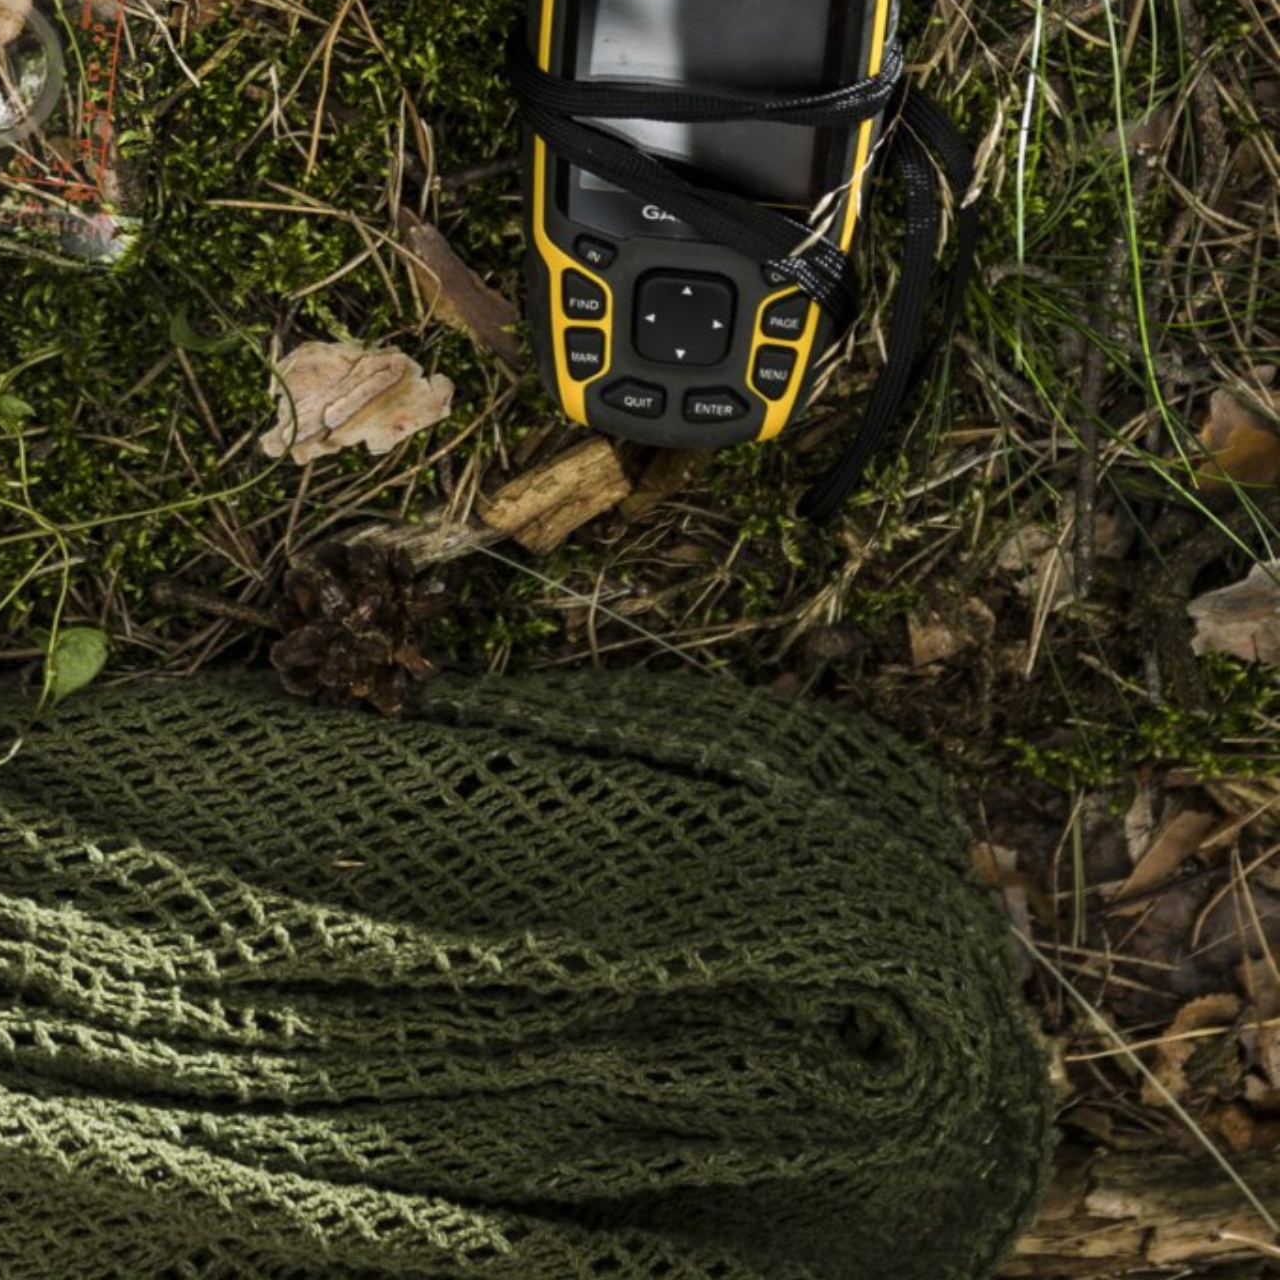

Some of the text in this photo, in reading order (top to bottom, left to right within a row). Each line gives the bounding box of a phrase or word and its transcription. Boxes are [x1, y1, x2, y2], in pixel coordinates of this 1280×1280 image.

[587, 250, 601, 263] IN
[569, 299, 599, 310] FIND
[770, 317, 800, 329] PAGE
[570, 351, 599, 363] MARK
[759, 368, 788, 381] MENU
[624, 396, 654, 409] QUIT
[694, 402, 733, 416] ENTER
